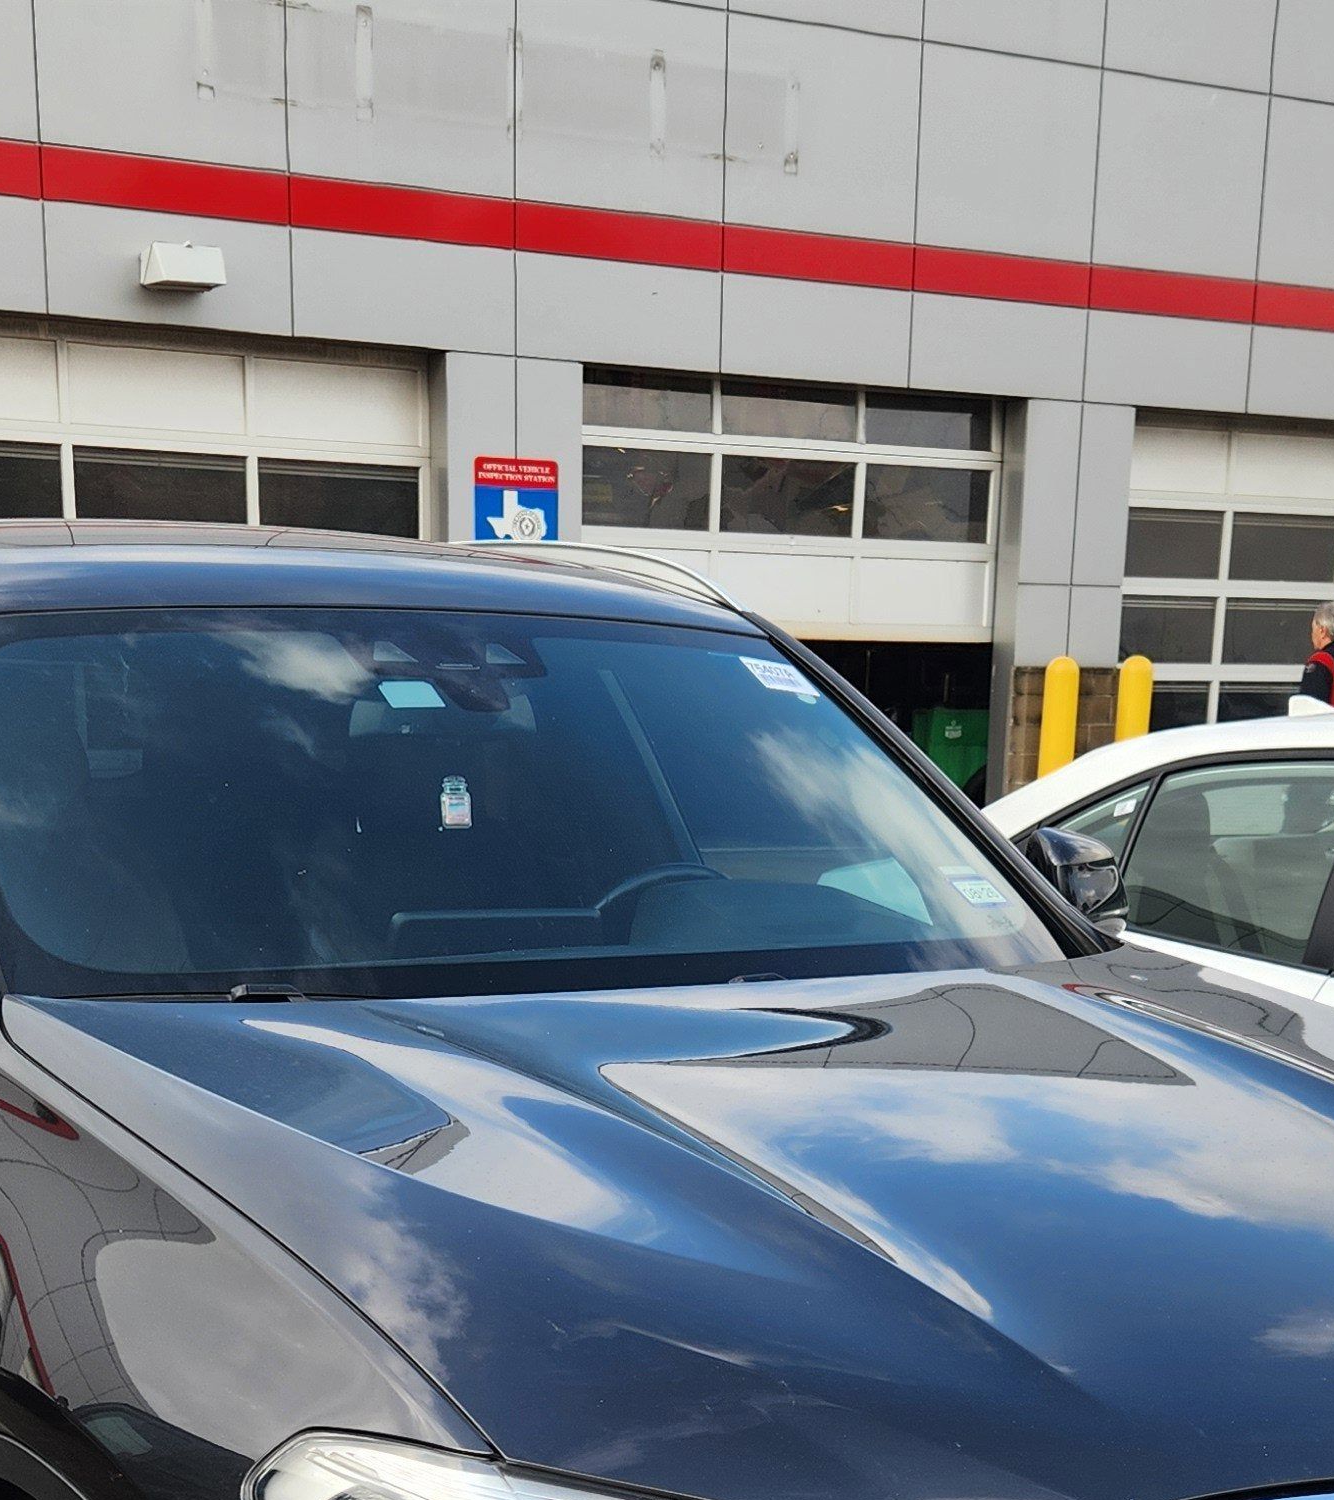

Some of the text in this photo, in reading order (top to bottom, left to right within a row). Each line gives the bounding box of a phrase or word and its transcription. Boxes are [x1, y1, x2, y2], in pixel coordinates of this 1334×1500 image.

[483, 463, 551, 474] OFFICIAL VEHICLE
[478, 472, 556, 483] INSPECTION STATION
